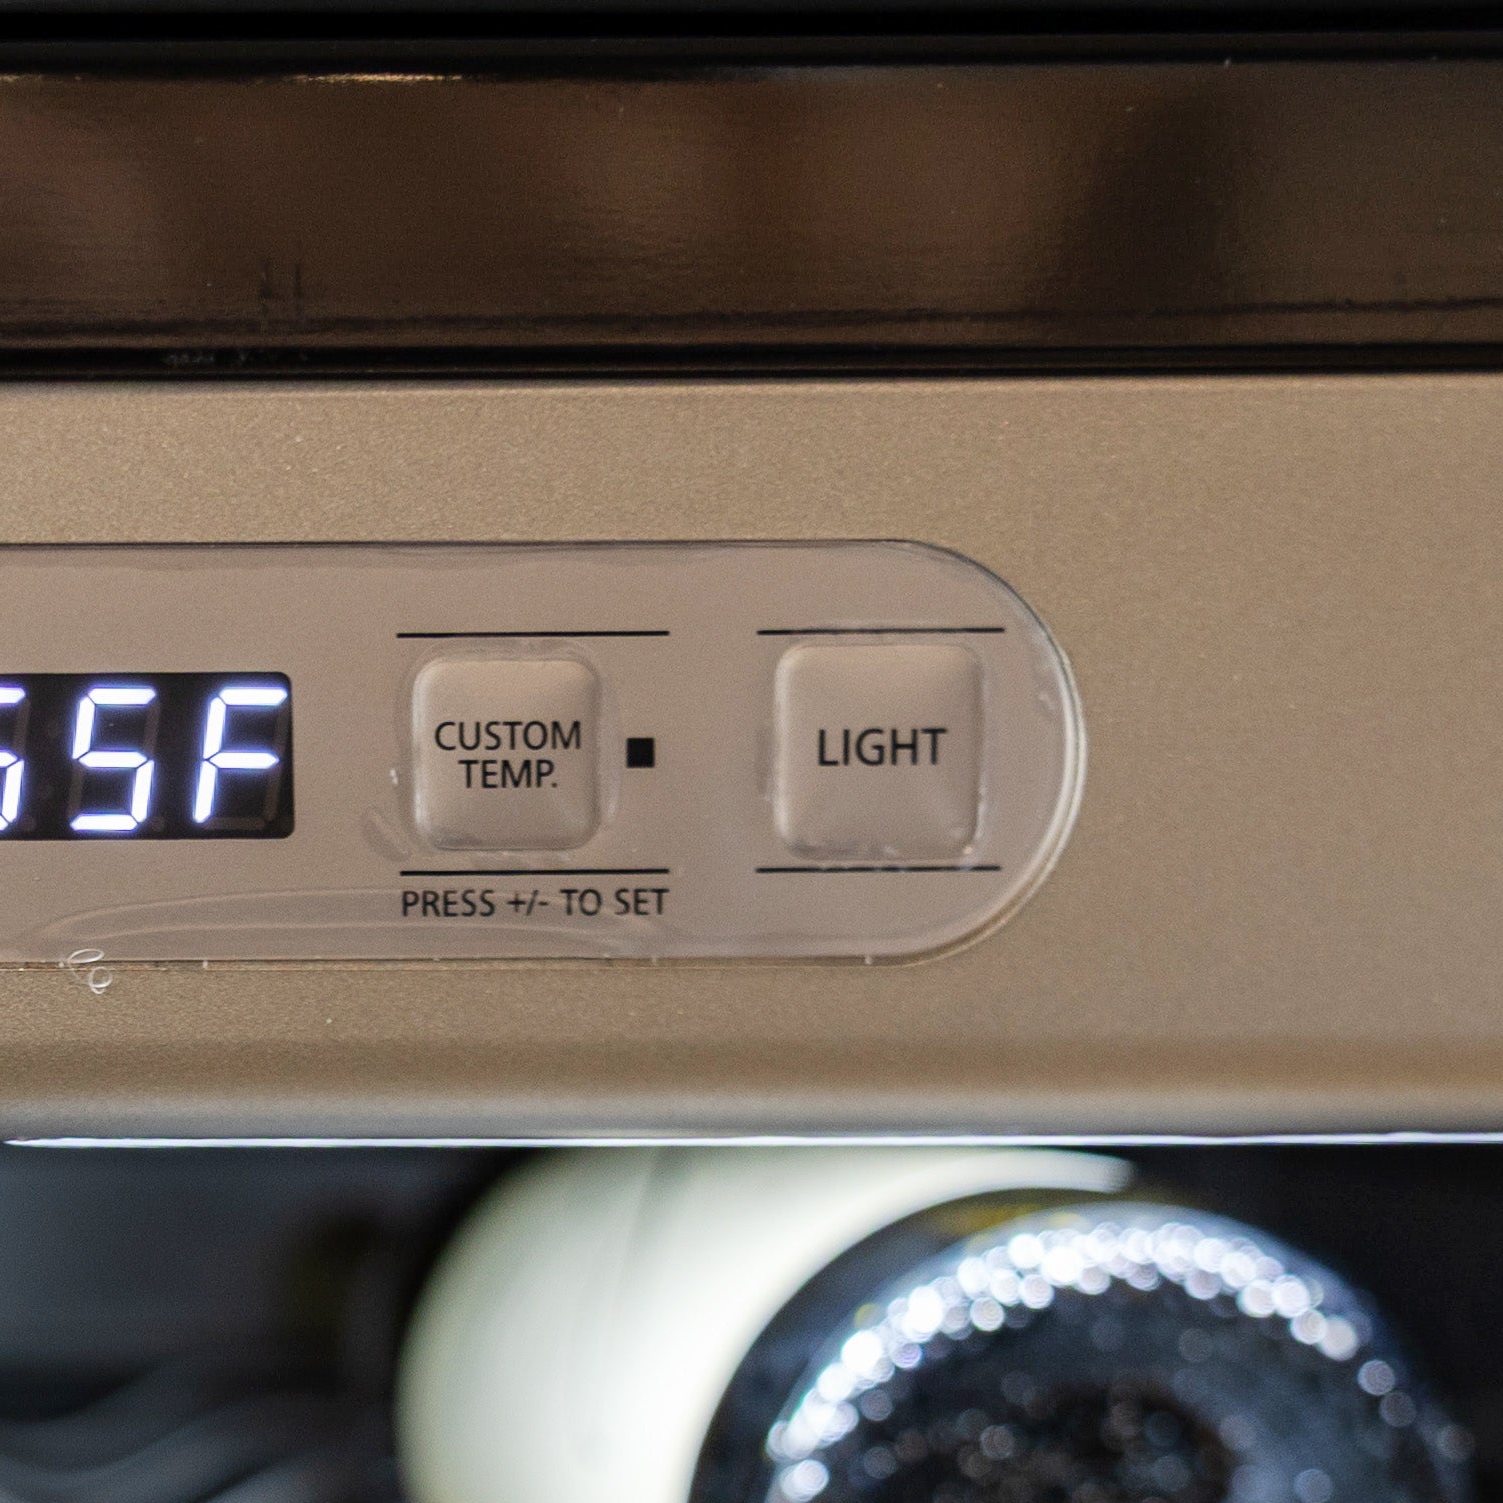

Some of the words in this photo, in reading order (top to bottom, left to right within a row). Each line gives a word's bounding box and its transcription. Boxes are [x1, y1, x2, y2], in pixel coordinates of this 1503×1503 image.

[434, 720, 581, 751] CUSTOM
[818, 727, 948, 767] LIGHT
[458, 758, 557, 789] TEMP.
[401, 889, 496, 918] PRESS
[506, 889, 549, 917] +/-
[559, 888, 603, 917] TO
[614, 887, 670, 916] SET
